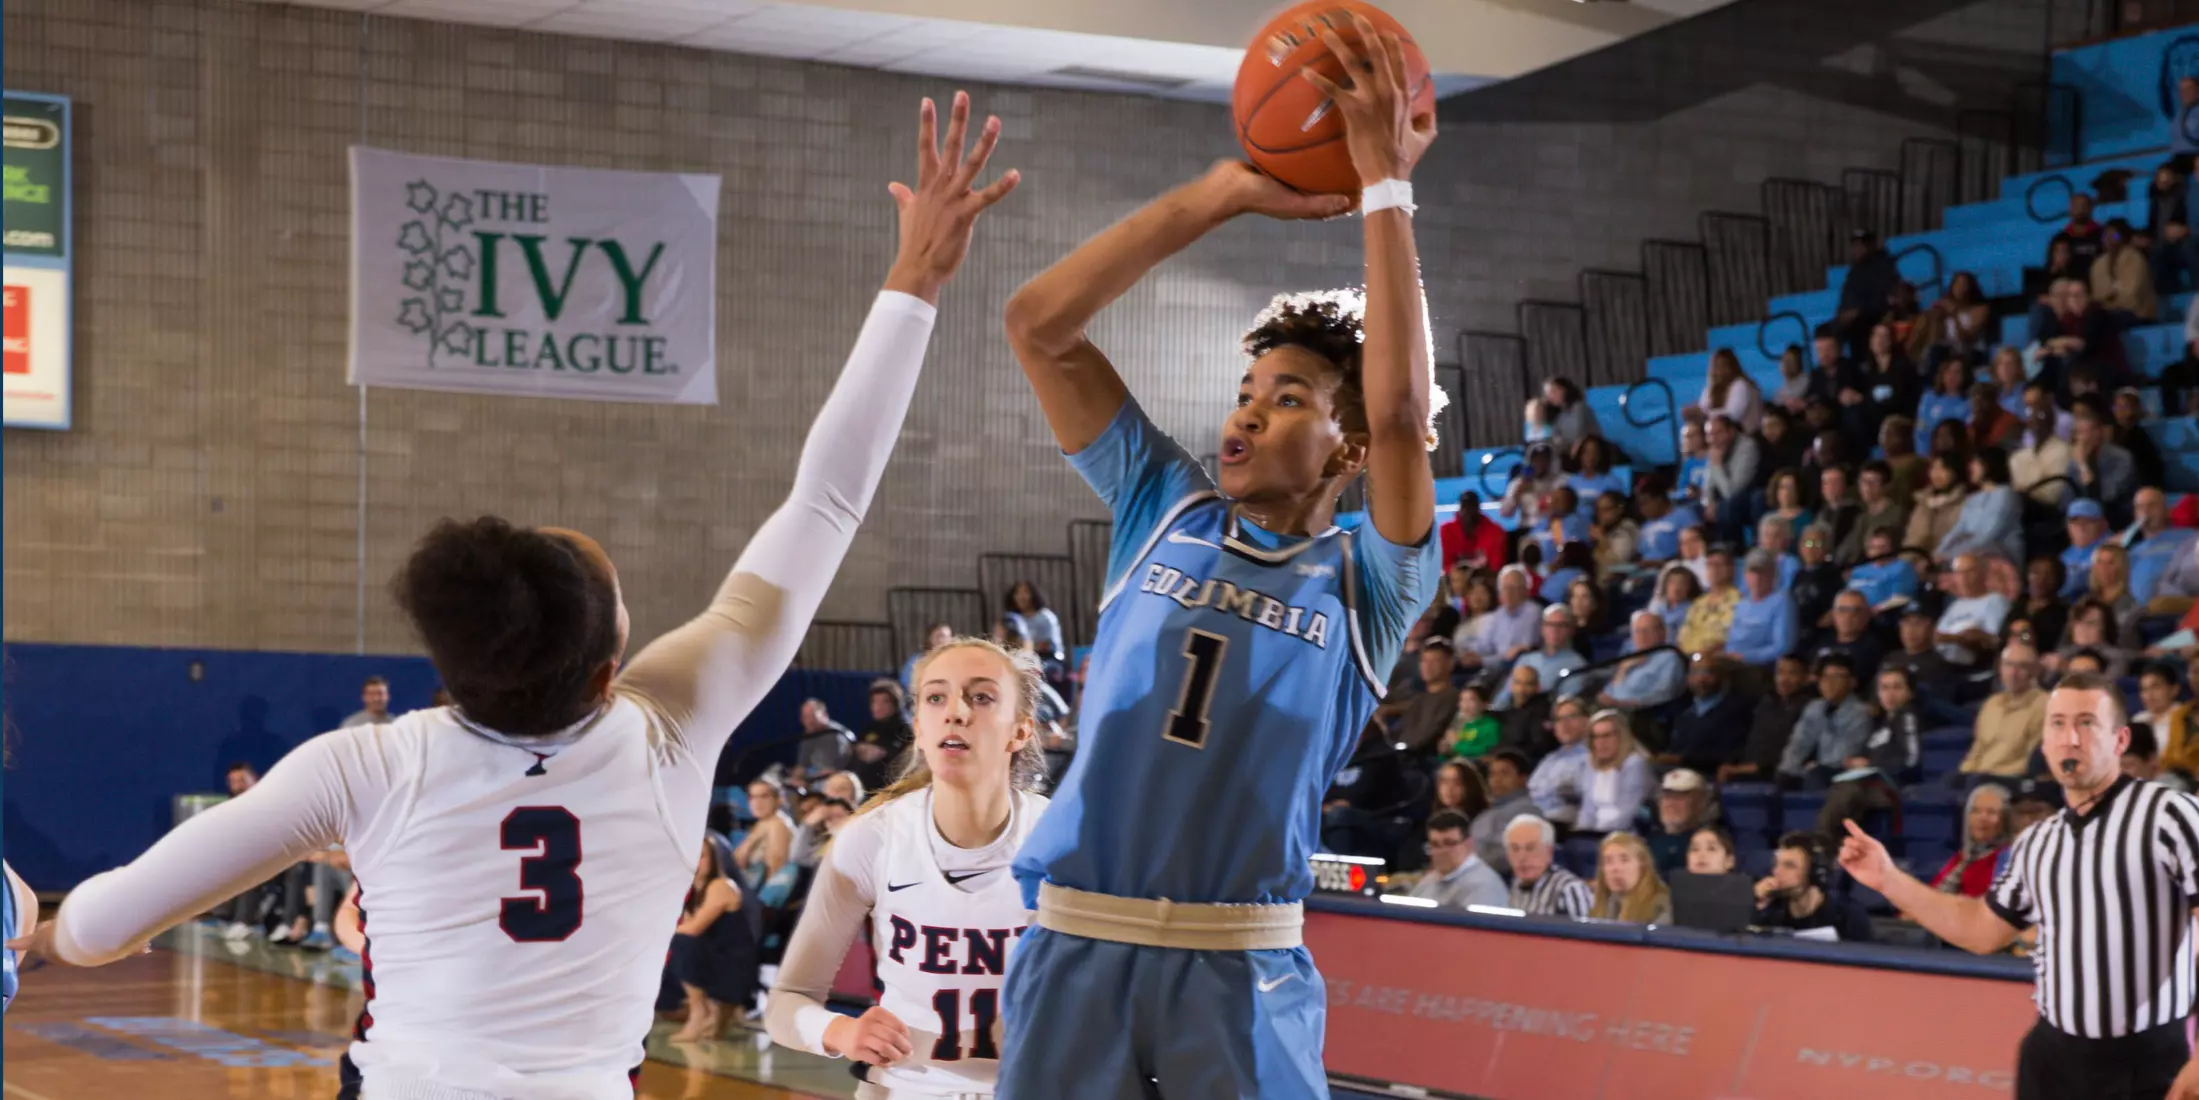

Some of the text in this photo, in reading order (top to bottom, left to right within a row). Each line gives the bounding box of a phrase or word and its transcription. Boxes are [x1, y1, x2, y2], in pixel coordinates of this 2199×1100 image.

[472, 188, 550, 224] THE
[471, 231, 667, 326] IVY
[474, 328, 669, 375] LEAGUE
[1140, 562, 1330, 650] COLUMBIA
[1161, 627, 1230, 749] 1
[499, 805, 584, 943] 3
[888, 914, 1028, 975] PEN
[930, 988, 1000, 1061] 11
[1354, 984, 1411, 1015] ARE
[1413, 993, 1598, 1042] HAPPENING
[1604, 1018, 1695, 1056] HERE
